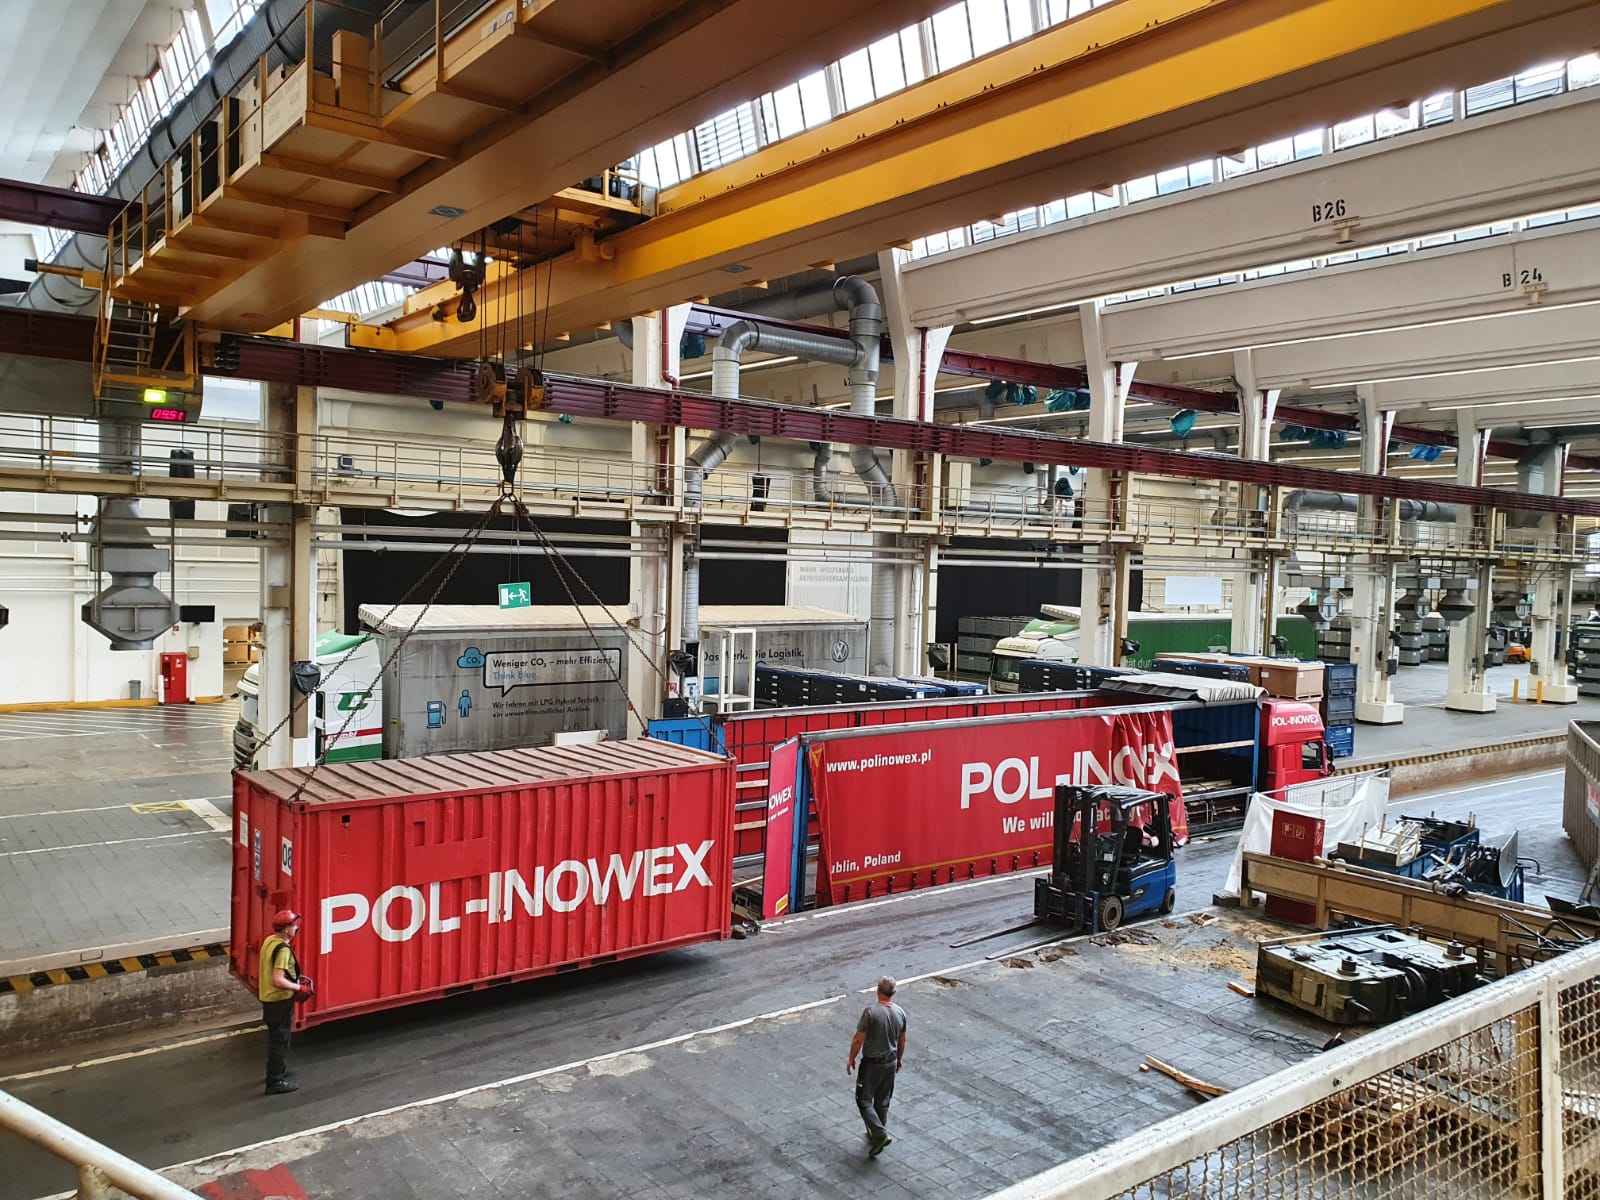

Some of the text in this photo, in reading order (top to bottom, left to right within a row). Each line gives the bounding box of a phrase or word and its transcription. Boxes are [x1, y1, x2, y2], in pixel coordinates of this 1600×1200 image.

[1312, 199, 1345, 222] B26
[492, 659, 528, 669] Weniger
[557, 656, 577, 665] mehr
[768, 647, 804, 661] Logistik.
[492, 671, 515, 680] Think
[1271, 714, 1320, 727] POL-INOWEX
[826, 748, 932, 772] www.polinowex.pl
[1002, 816, 1025, 834] We
[1030, 811, 1054, 829] will
[864, 850, 901, 868] Poland
[320, 839, 715, 955] POL-INOWEX
